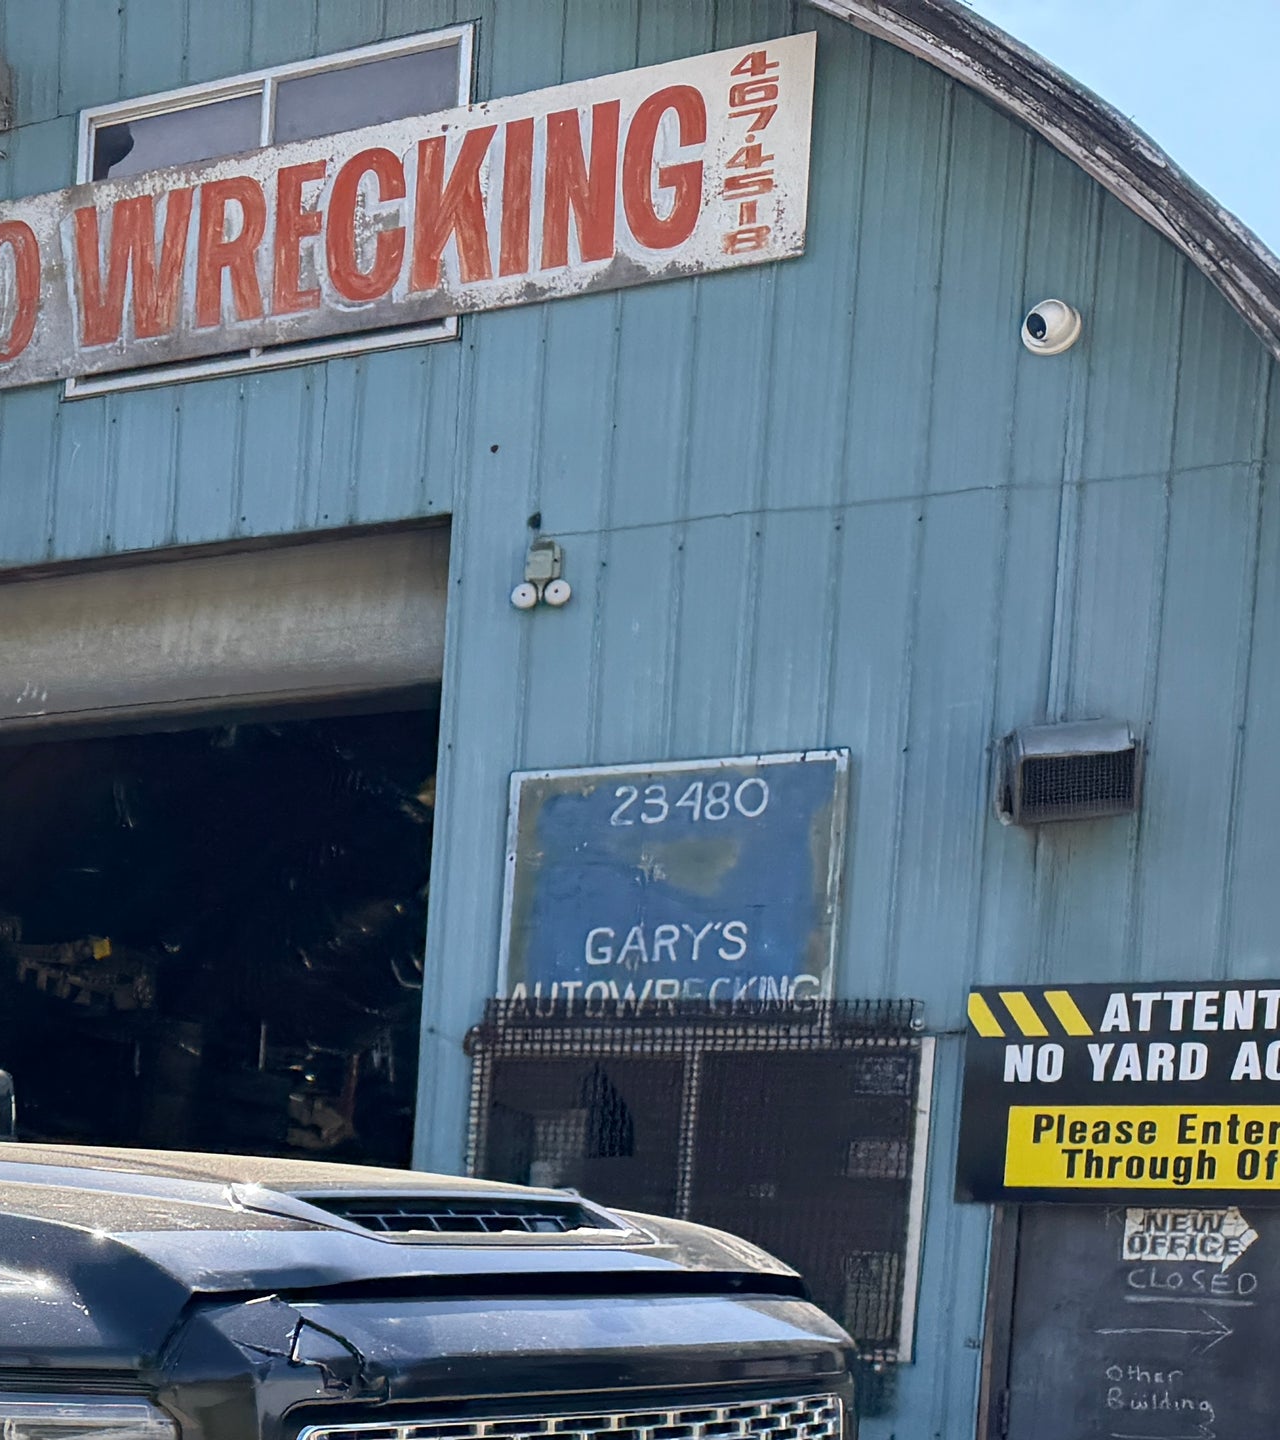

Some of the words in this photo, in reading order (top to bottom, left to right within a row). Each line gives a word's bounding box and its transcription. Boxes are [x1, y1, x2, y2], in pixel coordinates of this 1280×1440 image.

[74, 84, 708, 347] WRECKING
[610, 776, 770, 827] 23480
[585, 920, 749, 966] GARY'S
[1099, 989, 1280, 1033] ATTENT
[1003, 1043, 1066, 1083] NO
[1087, 1042, 1209, 1082] YARD
[1032, 1113, 1158, 1145] Please
[1178, 1113, 1280, 1145] Enter
[1061, 1149, 1217, 1186] Through
[1144, 1213, 1224, 1234] NEW
[1126, 1233, 1244, 1257] OFFICE
[1127, 1266, 1258, 1295] CLOSED
[1105, 1364, 1183, 1384] Other
